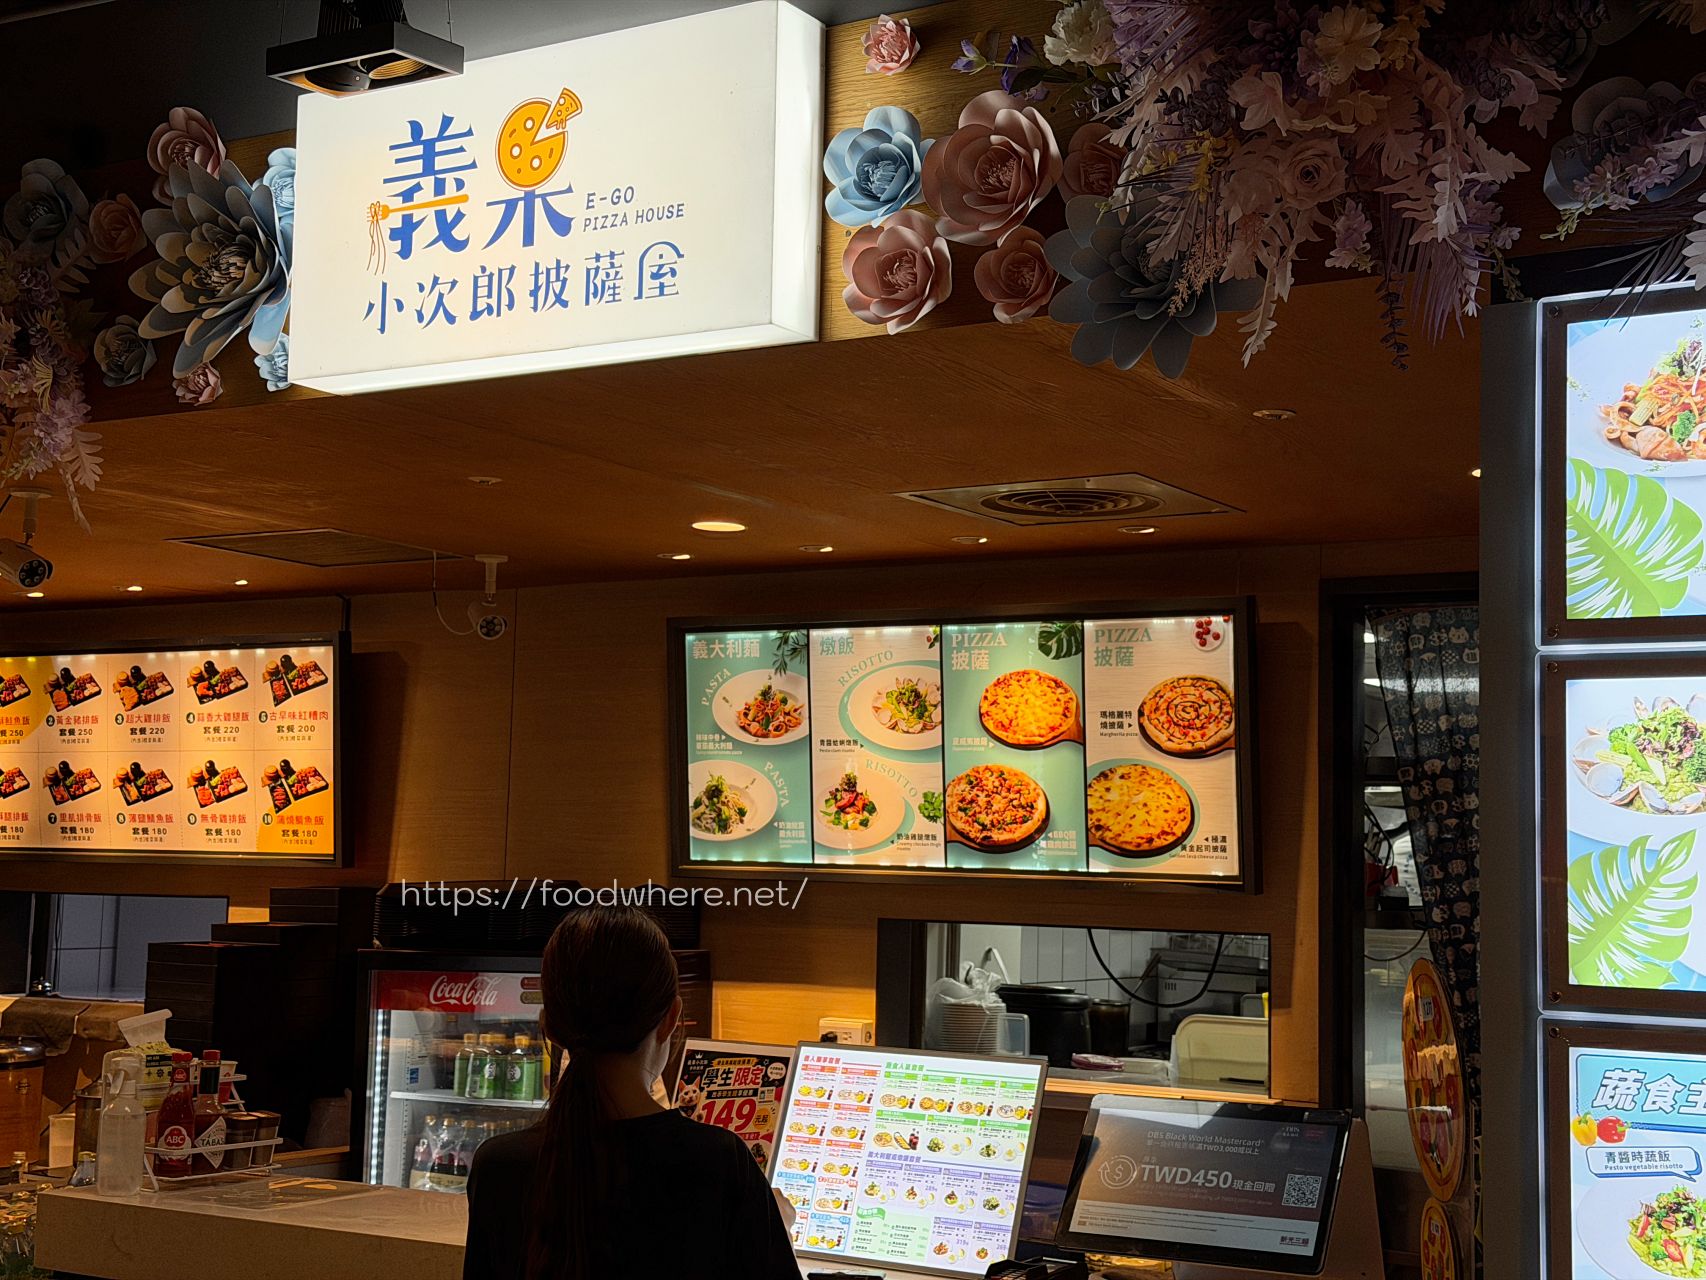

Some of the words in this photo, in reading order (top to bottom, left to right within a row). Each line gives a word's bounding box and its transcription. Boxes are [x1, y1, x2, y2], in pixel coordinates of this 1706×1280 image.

[585, 185, 635, 210] E-GO
[582, 213, 630, 233] PIZZA
[634, 202, 685, 225] HOUSE
[362, 241, 685, 335] 小次郎披薩屋
[952, 632, 1008, 648] PIZZA
[1094, 626, 1152, 644] PIZZA
[692, 637, 760, 660] 義大利麵
[819, 636, 855, 656] 燉飯
[951, 650, 990, 671] 披薩
[1094, 646, 1135, 667] 披薩
[837, 650, 894, 687] RISOTTO
[701, 667, 732, 706] PASTA
[9, 729, 24, 737] 250
[78, 728, 93, 736] 250
[149, 727, 165, 735] 220
[223, 726, 240, 734] 220
[297, 725, 316, 733] 200
[763, 761, 790, 808] PASTA
[864, 758, 918, 798] RISOTTO
[79, 826, 95, 834] 180
[152, 827, 168, 835] 180
[225, 828, 241, 836] 180
[429, 975, 502, 1007] Coca-Cola
[702, 1066, 764, 1089] 學生限定
[701, 1098, 757, 1133] 149
[166, 1135, 185, 1144] ABC
[1166, 1132, 1187, 1142] Black
[1188, 1134, 1213, 1143] World
[1604, 1150, 1671, 1164] 青醬時蔬飯
[1624, 1163, 1659, 1171] vegetable
[1141, 1163, 1232, 1189] TWD450
